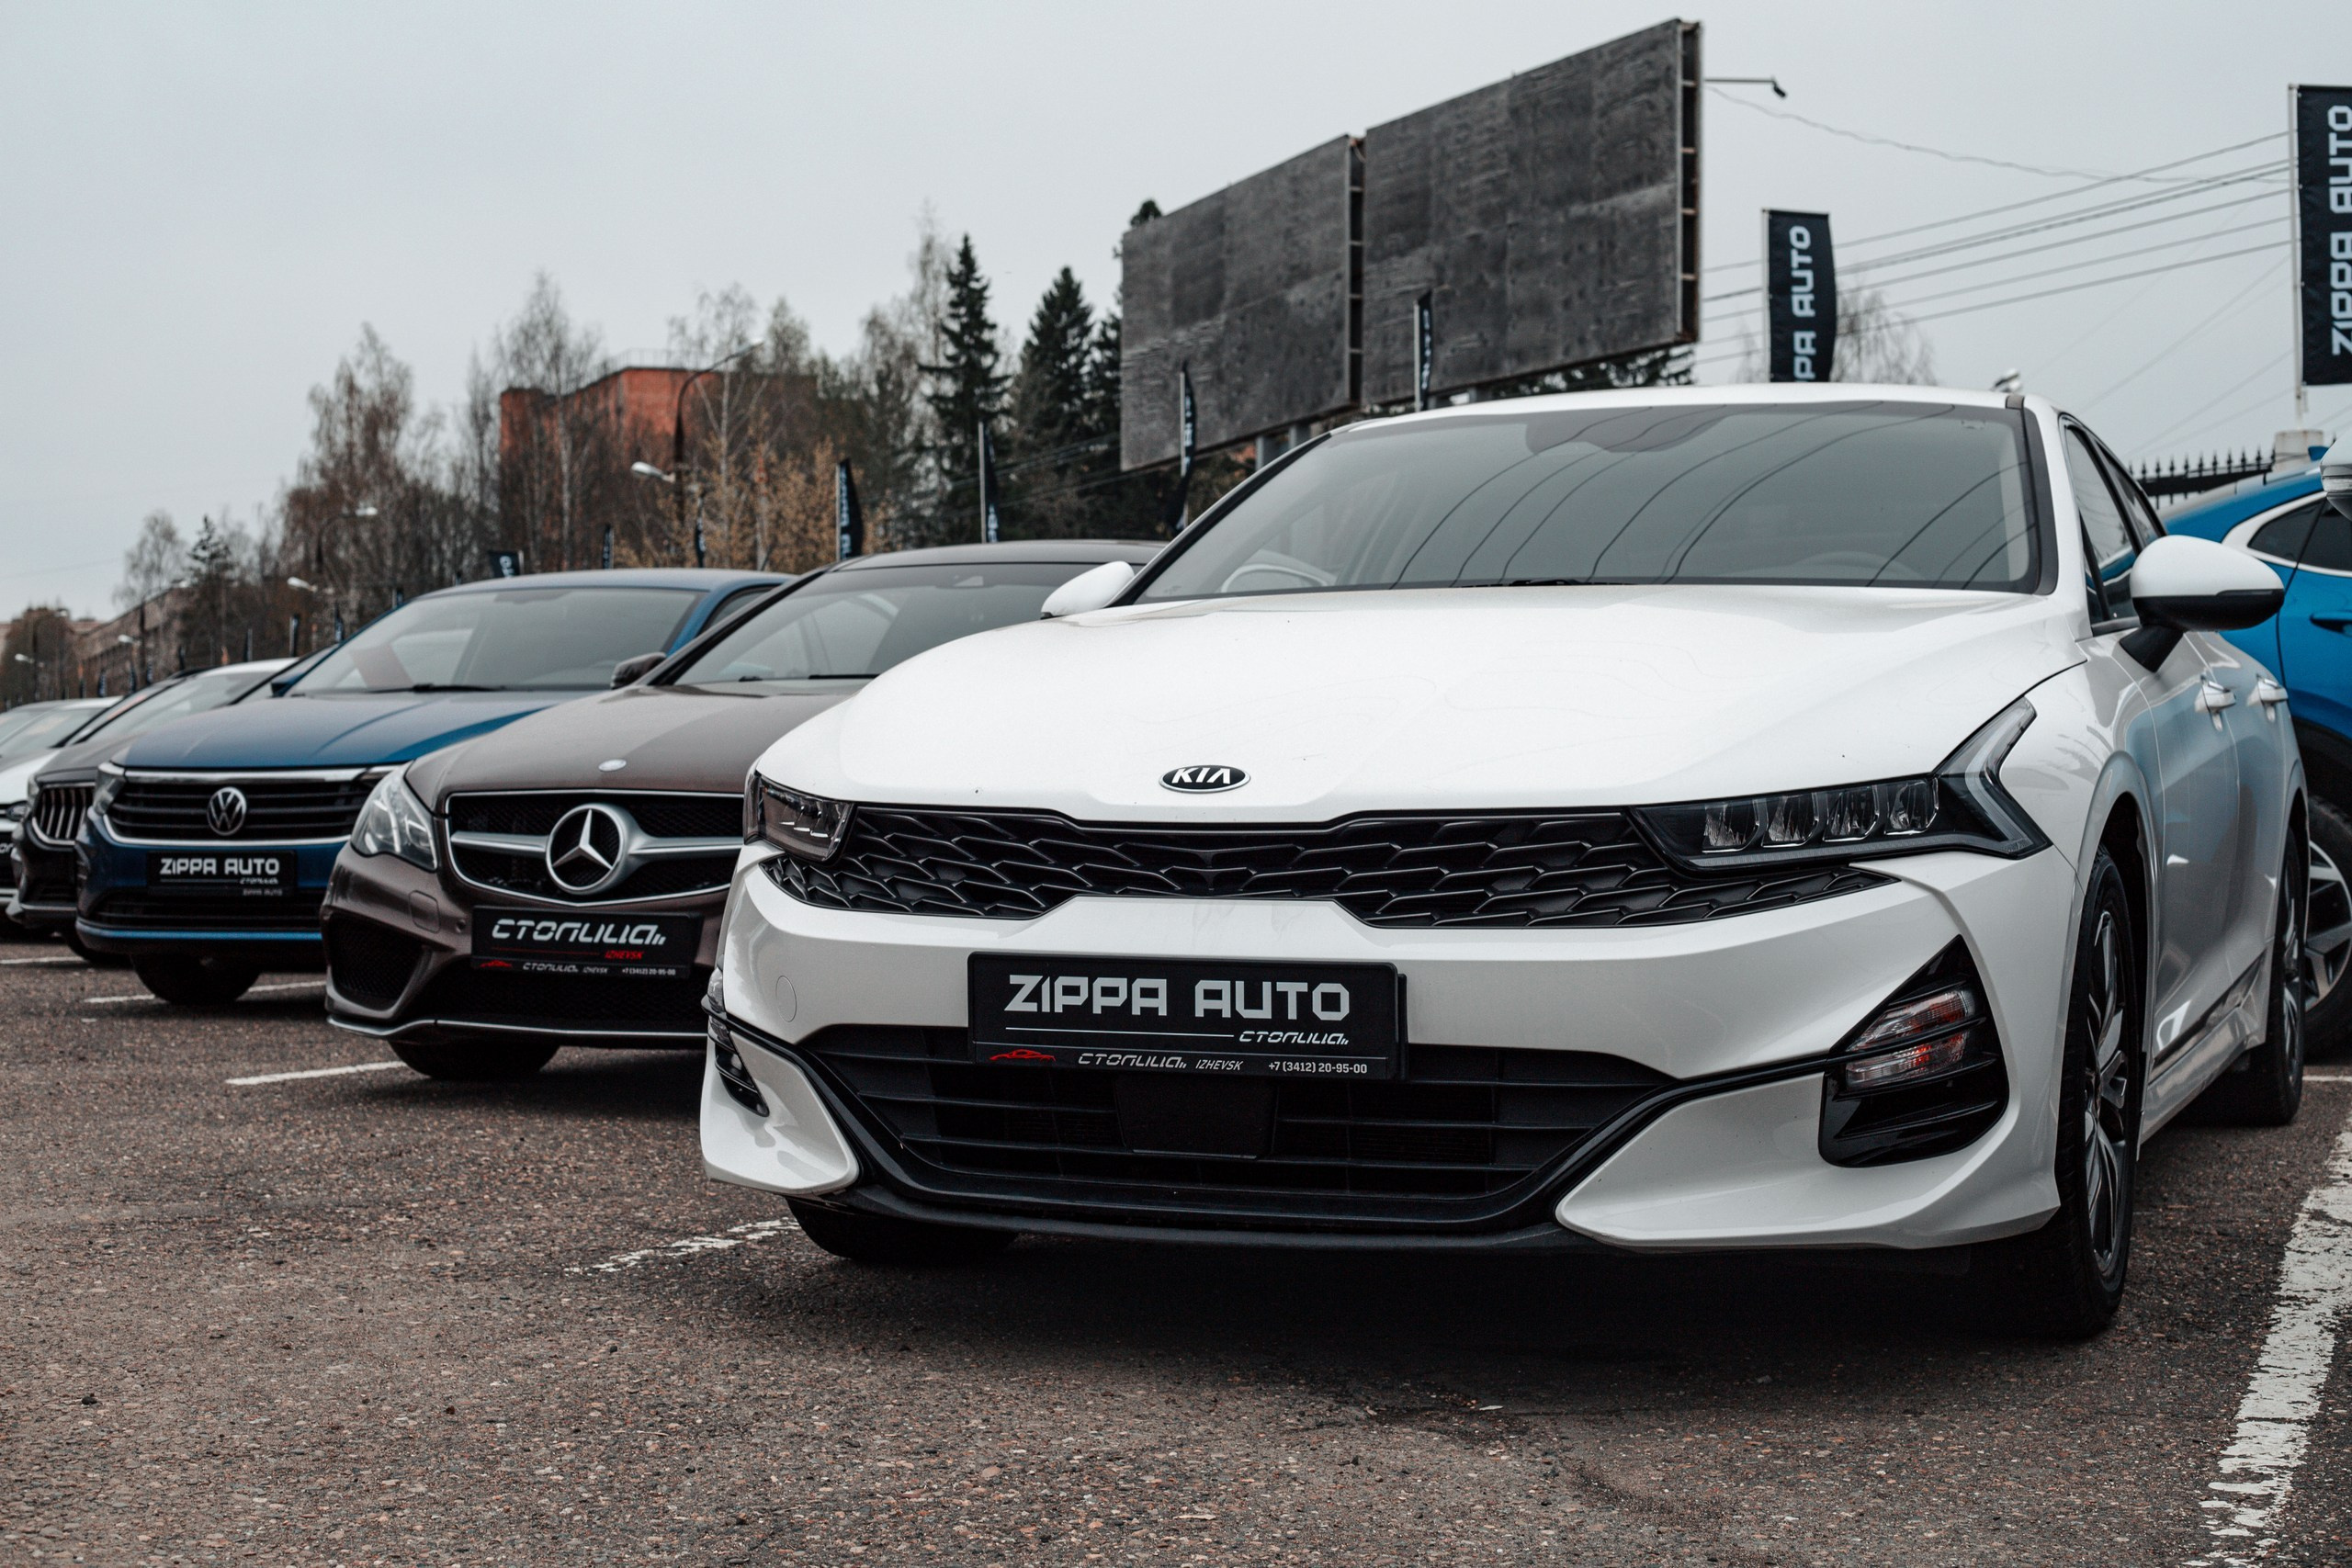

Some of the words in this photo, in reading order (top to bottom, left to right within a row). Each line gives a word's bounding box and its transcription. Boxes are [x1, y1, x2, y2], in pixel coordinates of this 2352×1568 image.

[1790, 225, 1815, 317] AUTO
[1793, 331, 1817, 382] PA
[1171, 767, 1231, 784] KIA
[160, 858, 217, 874] ZIPPA
[224, 858, 280, 875] AUTO
[1004, 975, 1168, 1016] ZIPPA
[1194, 979, 1351, 1021] AUTO
[1195, 1059, 1244, 1071] IZHEVSK
[1269, 1062, 1281, 1072] +7
[1282, 1061, 1317, 1074] (3412)
[1317, 1062, 1368, 1074] 20-95-00
